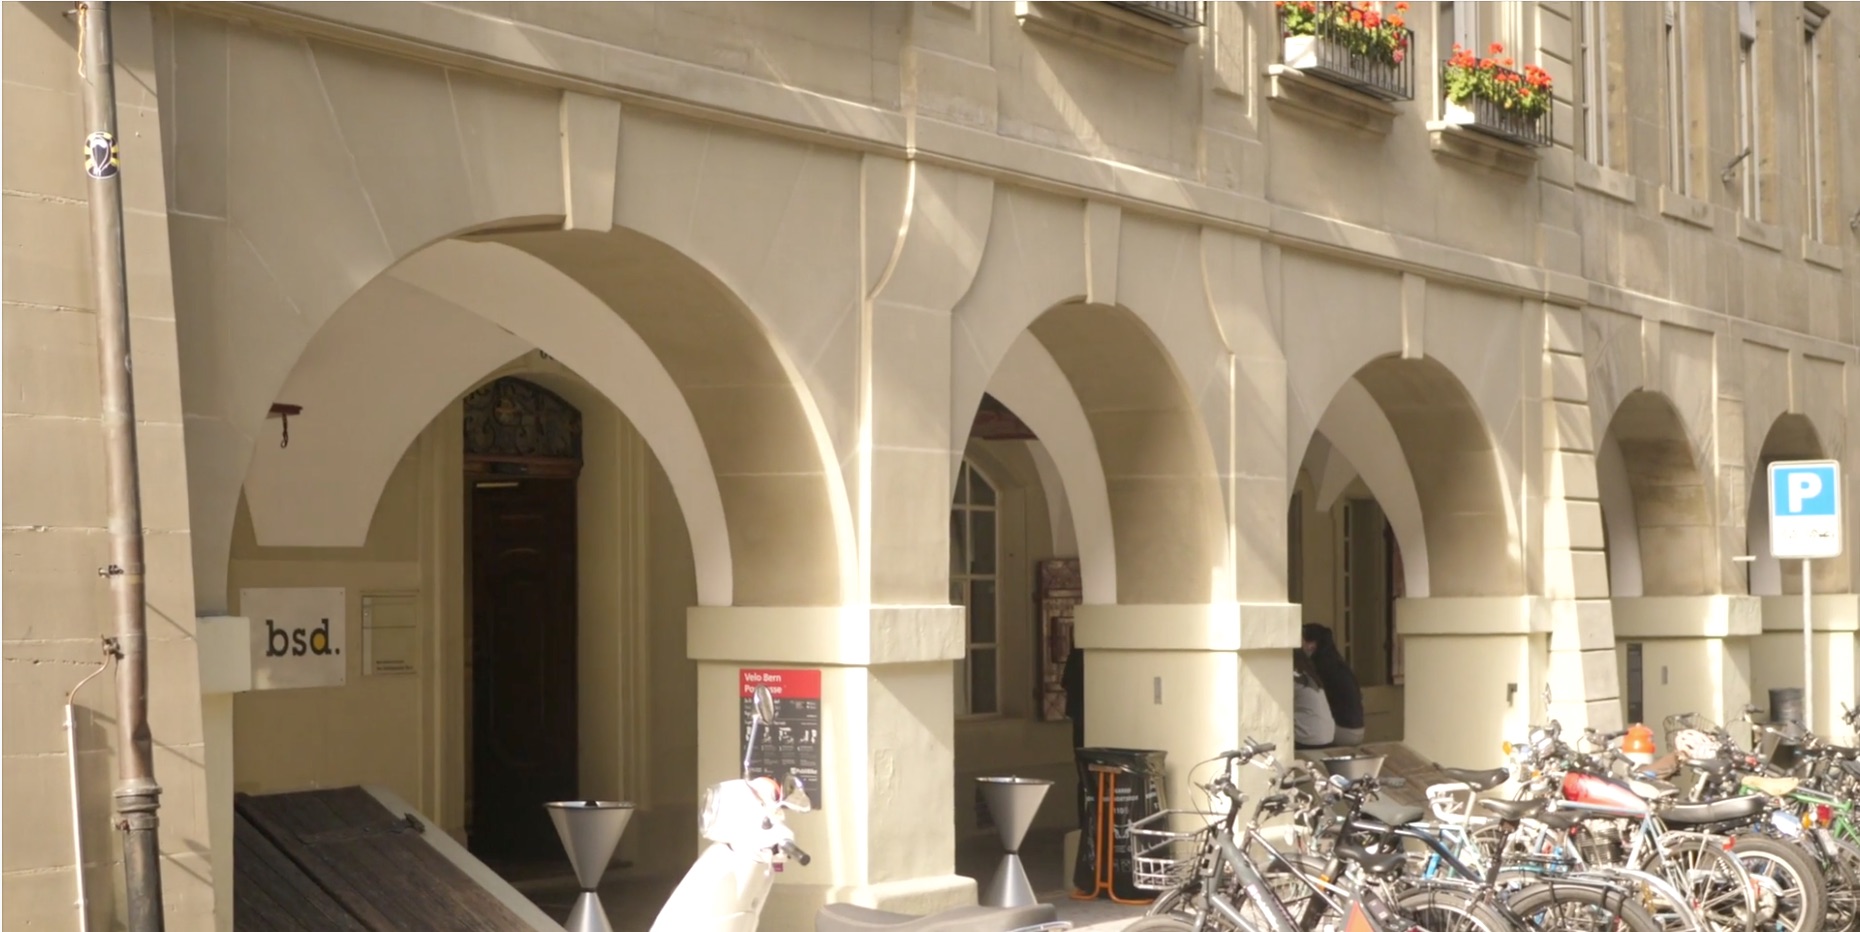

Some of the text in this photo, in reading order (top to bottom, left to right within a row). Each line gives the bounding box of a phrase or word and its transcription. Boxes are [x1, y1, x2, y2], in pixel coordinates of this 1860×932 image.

[1788, 472, 1822, 513] P
[265, 618, 341, 657] bsd.
[744, 673, 782, 682] Velo Bern
